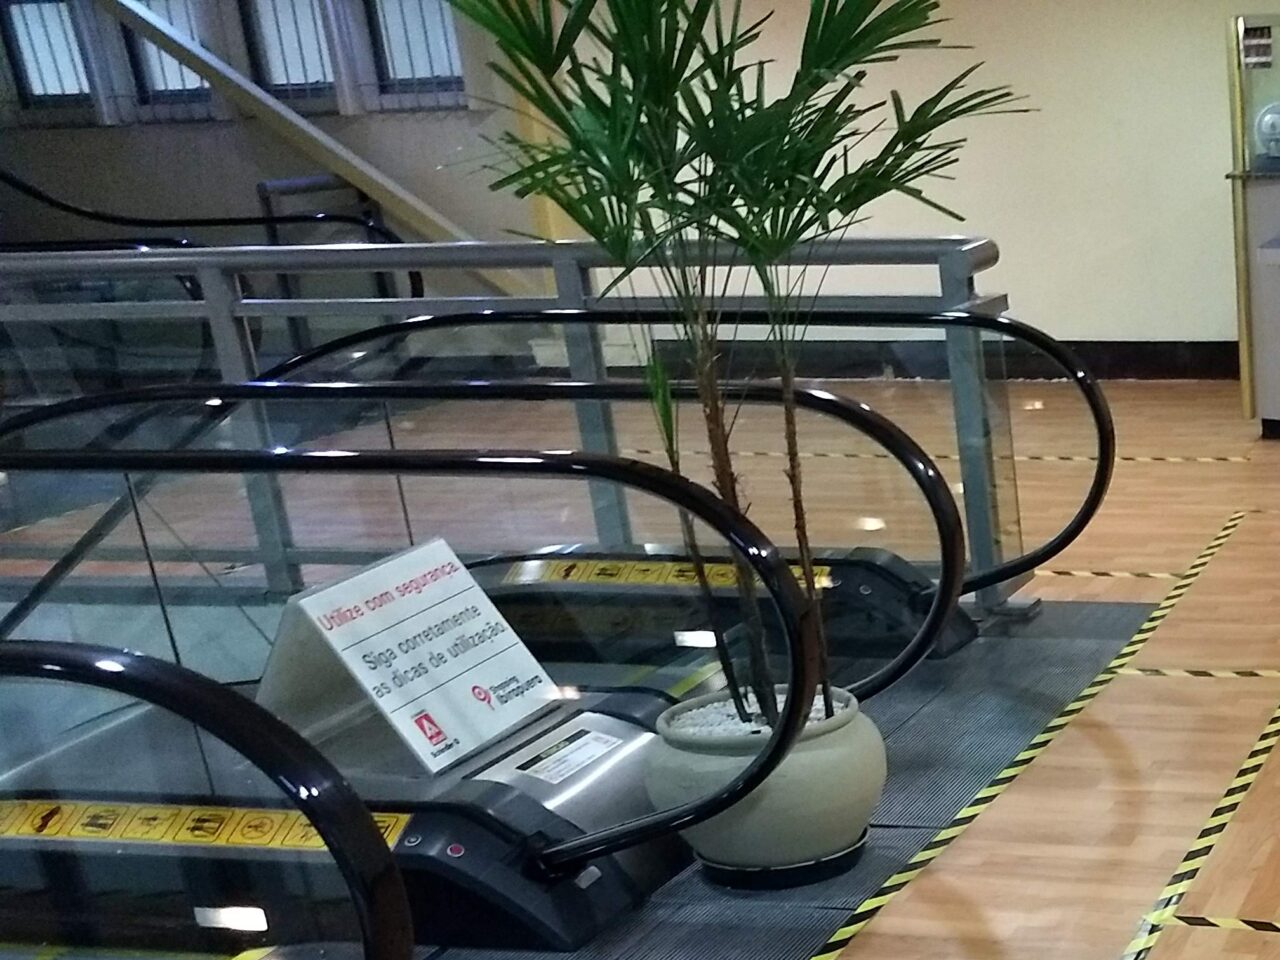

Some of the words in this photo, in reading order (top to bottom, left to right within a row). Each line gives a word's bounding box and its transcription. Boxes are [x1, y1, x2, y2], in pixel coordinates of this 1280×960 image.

[317, 602, 365, 631] Utilize
[365, 590, 395, 612] com
[362, 647, 397, 670] Siga
[398, 603, 482, 655] corretamente
[372, 682, 391, 698] as
[392, 660, 429, 688] dicas
[429, 650, 448, 669] de
